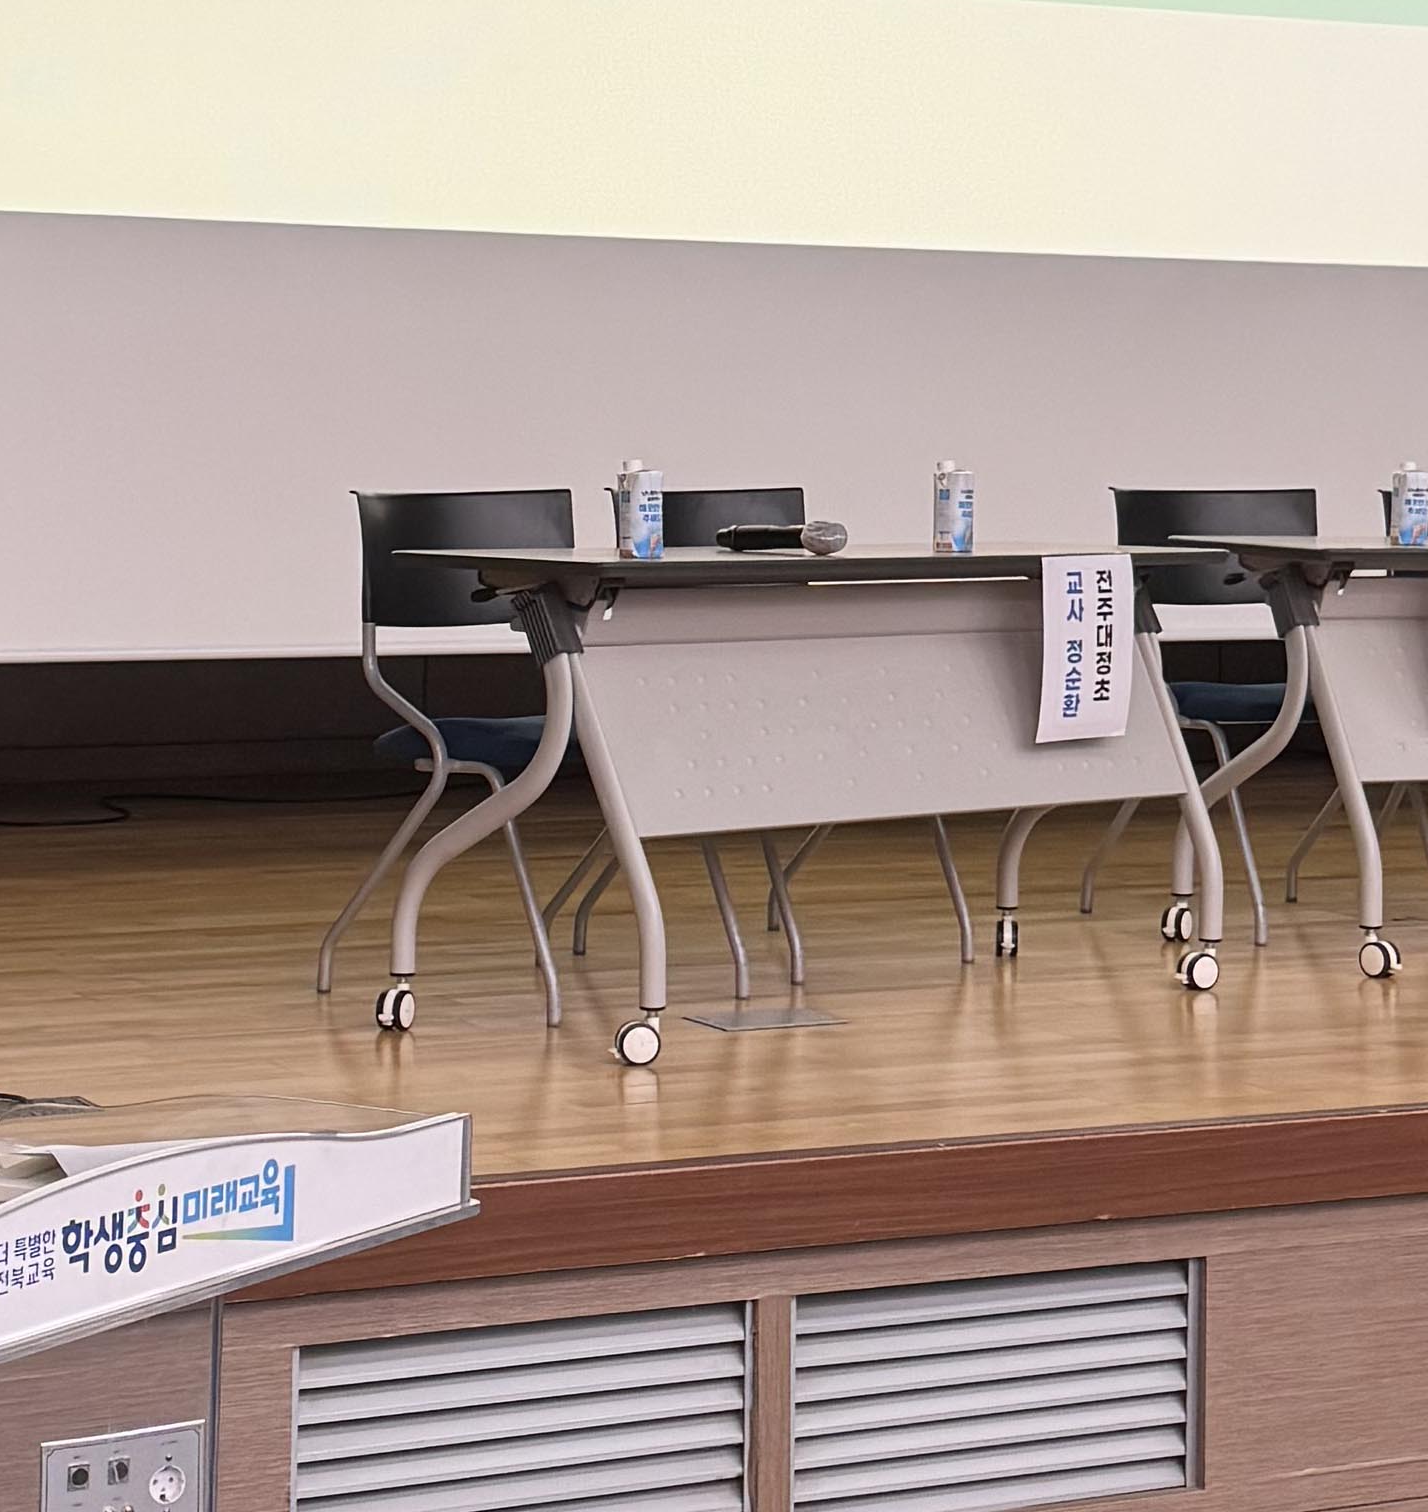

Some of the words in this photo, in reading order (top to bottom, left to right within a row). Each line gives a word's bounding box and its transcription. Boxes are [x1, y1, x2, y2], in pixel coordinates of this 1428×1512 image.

[1067, 572, 1083, 622] 교사
[1094, 570, 1113, 701] 전주대정초
[1063, 640, 1082, 718] 정순환
[62, 1183, 179, 1274] 학생중심
[182, 1158, 281, 1223] 미래교육
